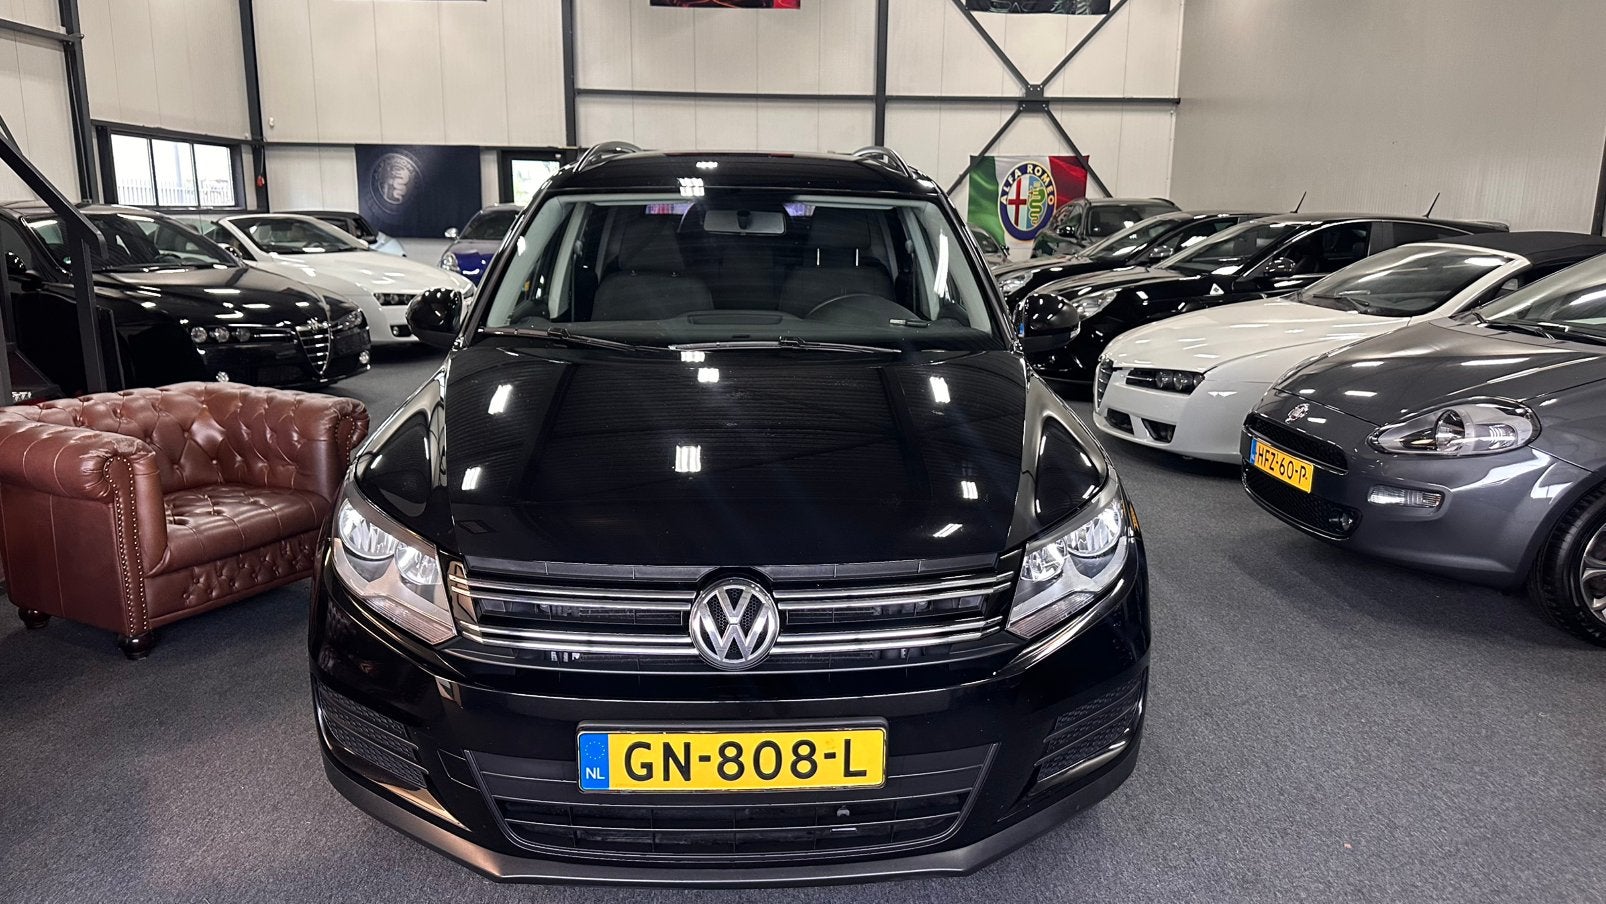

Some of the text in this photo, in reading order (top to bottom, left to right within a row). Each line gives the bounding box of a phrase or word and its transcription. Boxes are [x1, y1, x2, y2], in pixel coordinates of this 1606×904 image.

[1000, 164, 1055, 205] ALFA ROMEO
[1257, 446, 1307, 484] HFZ-60-P
[585, 766, 606, 780] NL
[624, 738, 867, 782] GN-808-L
